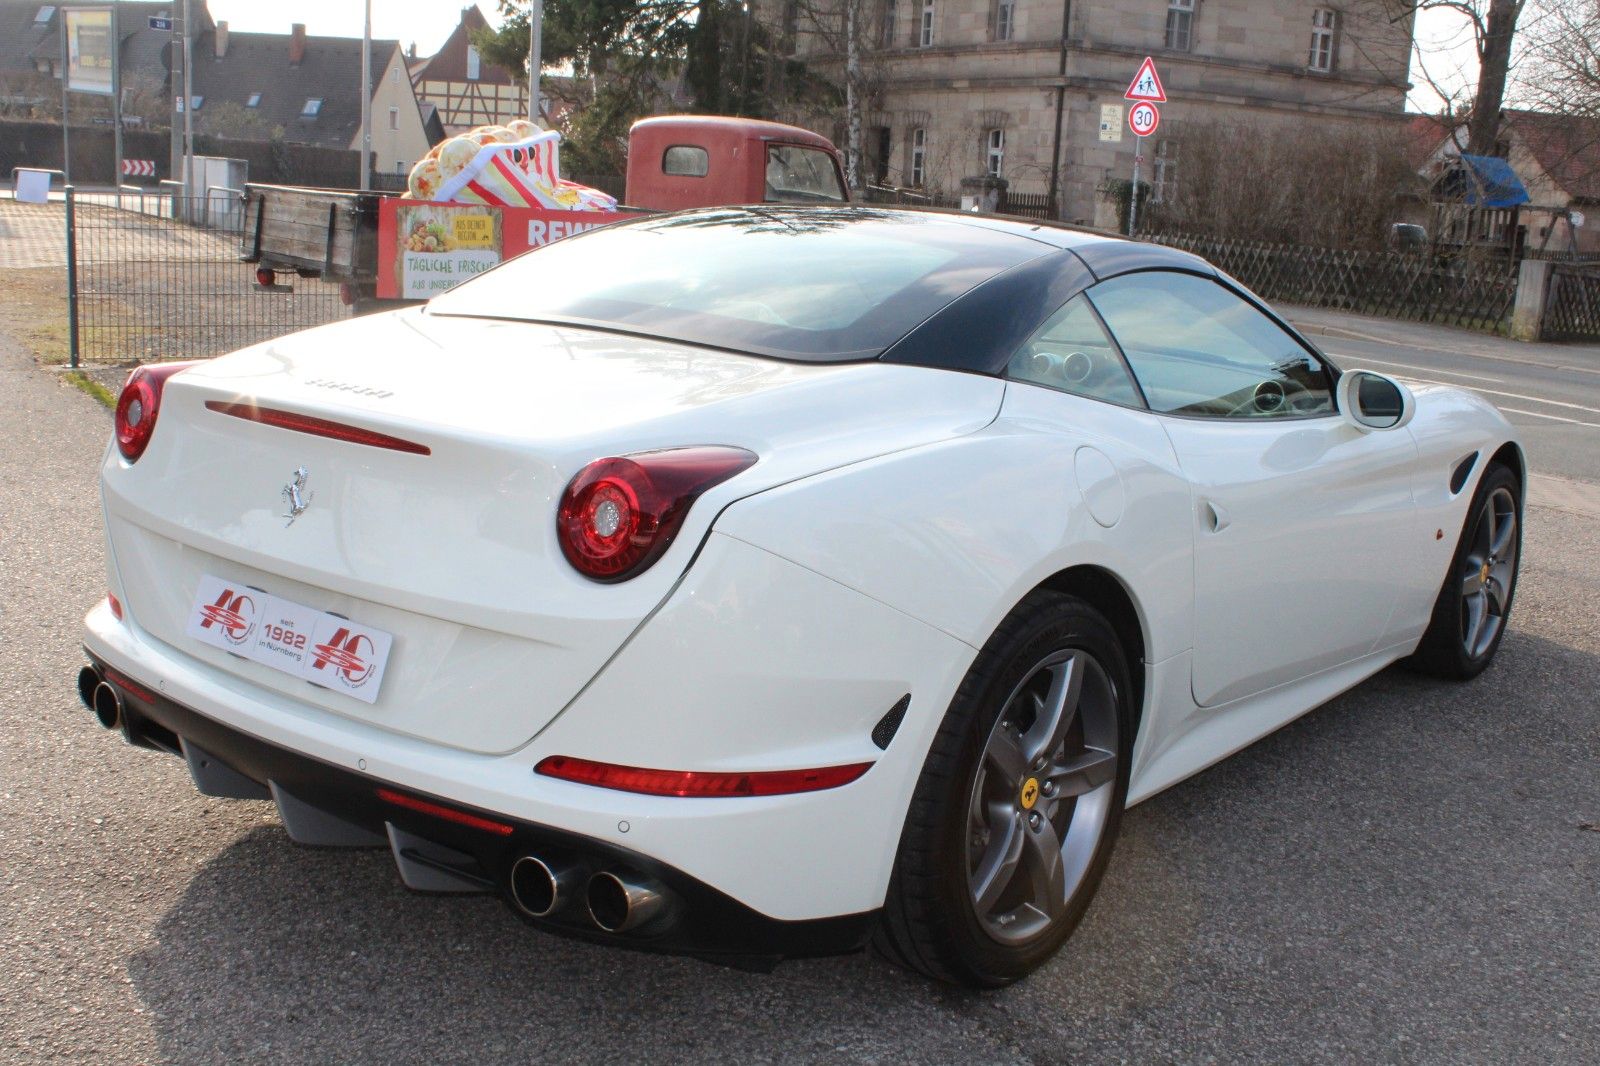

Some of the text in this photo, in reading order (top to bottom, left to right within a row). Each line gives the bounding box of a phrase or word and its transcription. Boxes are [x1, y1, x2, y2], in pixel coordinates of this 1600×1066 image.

[1135, 111, 1152, 126] 30
[455, 220, 467, 230] AUS
[412, 279, 426, 290] AUS
[280, 618, 295, 628] seit
[264, 623, 307, 650] 1982
